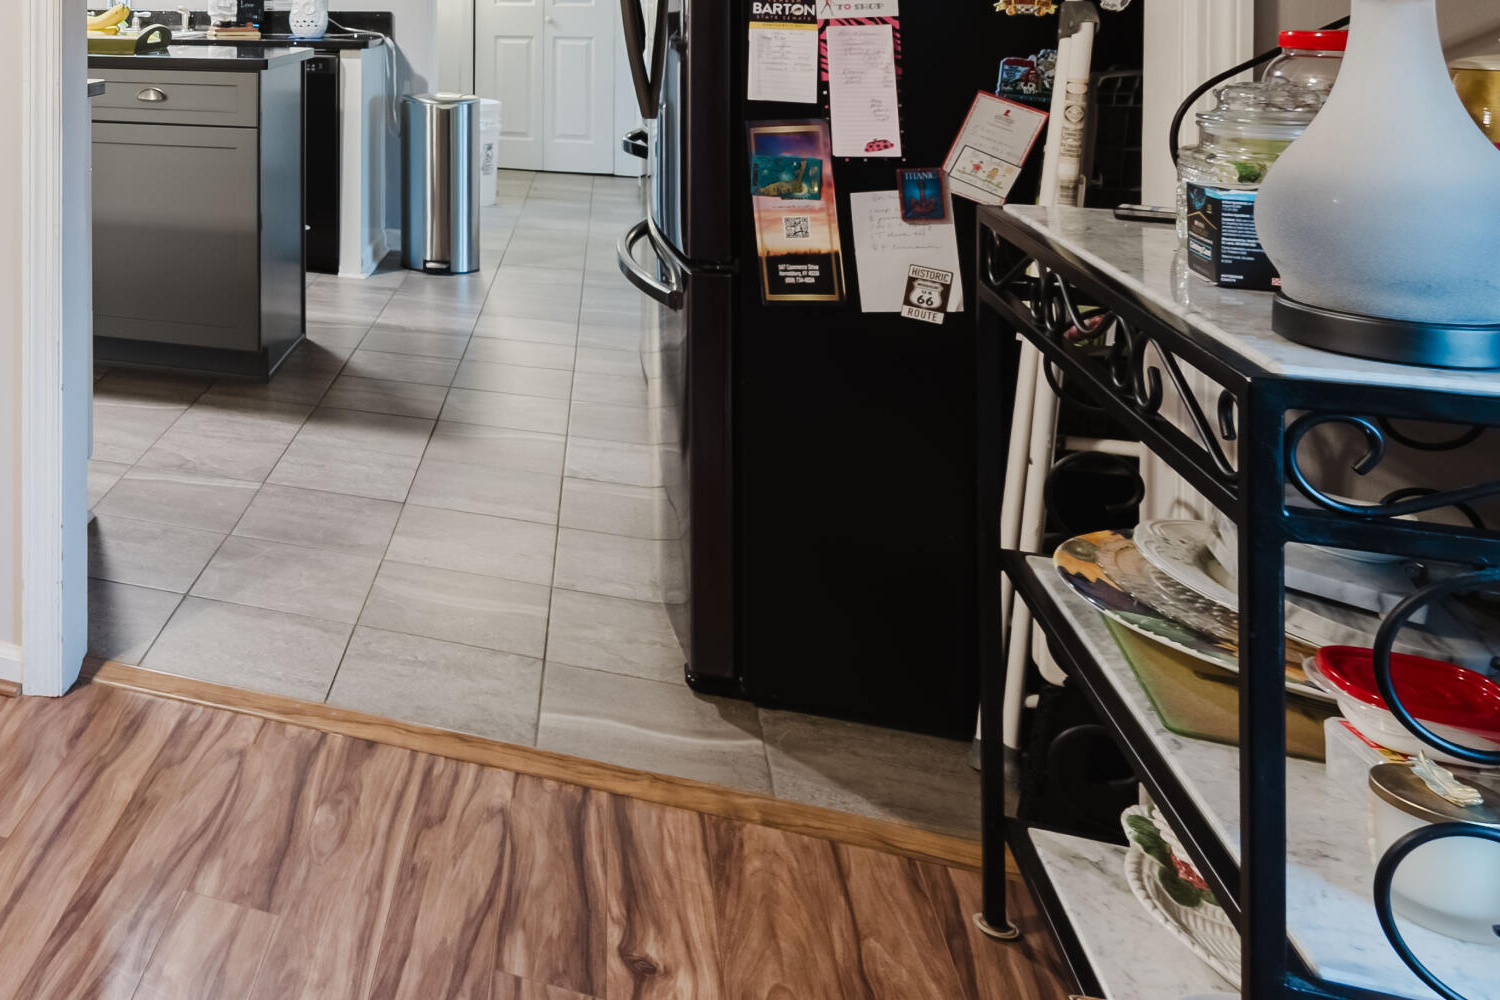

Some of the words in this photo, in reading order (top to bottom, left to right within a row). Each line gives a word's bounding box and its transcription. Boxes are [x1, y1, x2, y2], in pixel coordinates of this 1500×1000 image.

[752, 2, 816, 16] BARTON
[911, 268, 950, 284] HISTORIC
[916, 295, 934, 307] 66
[906, 307, 938, 322] ROUTE
